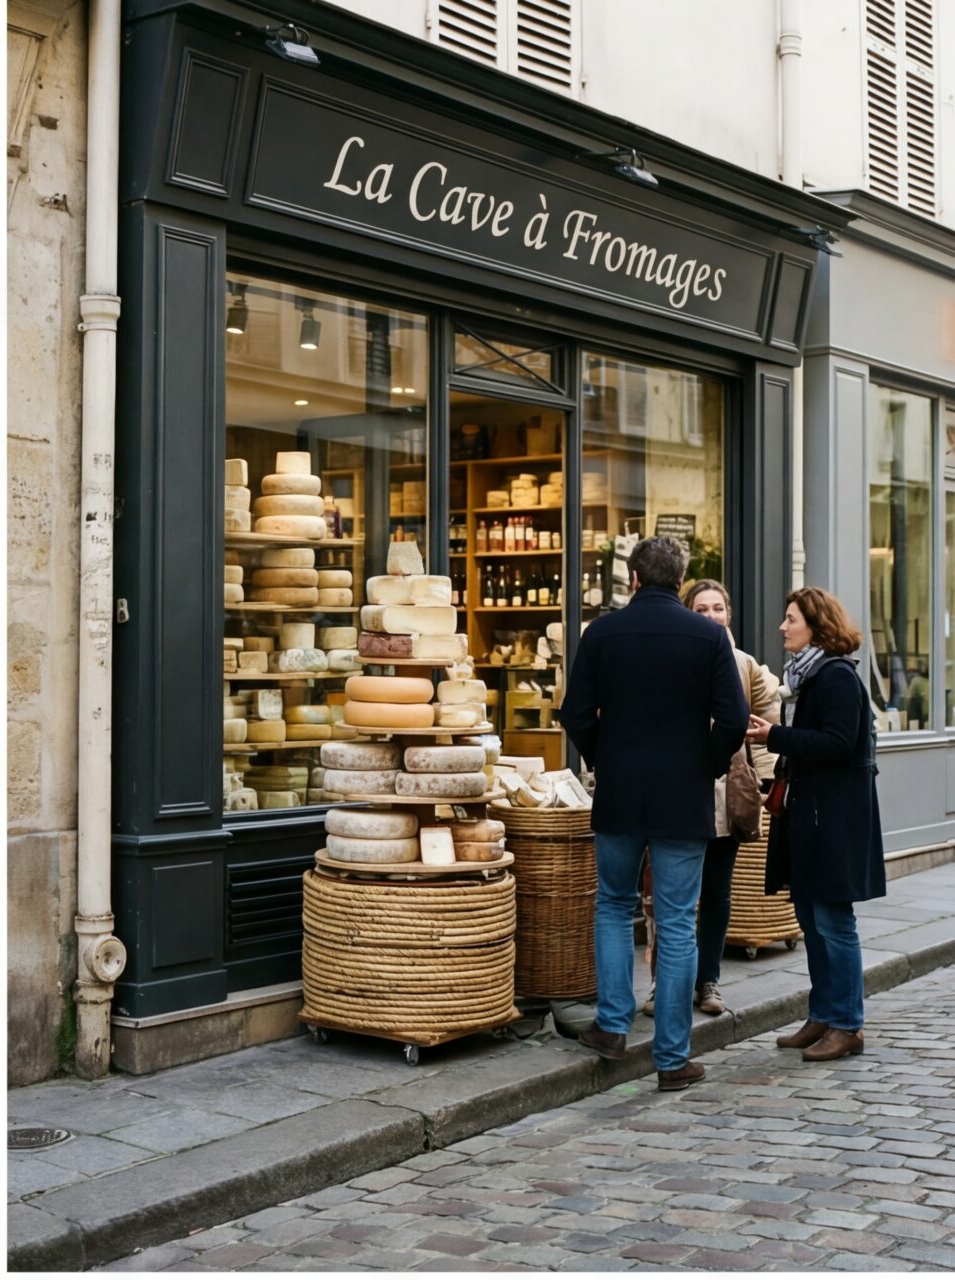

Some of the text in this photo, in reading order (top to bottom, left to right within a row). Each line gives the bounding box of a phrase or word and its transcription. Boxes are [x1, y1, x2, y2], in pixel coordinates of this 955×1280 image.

[323, 136, 728, 309] La Cave à Fromages
